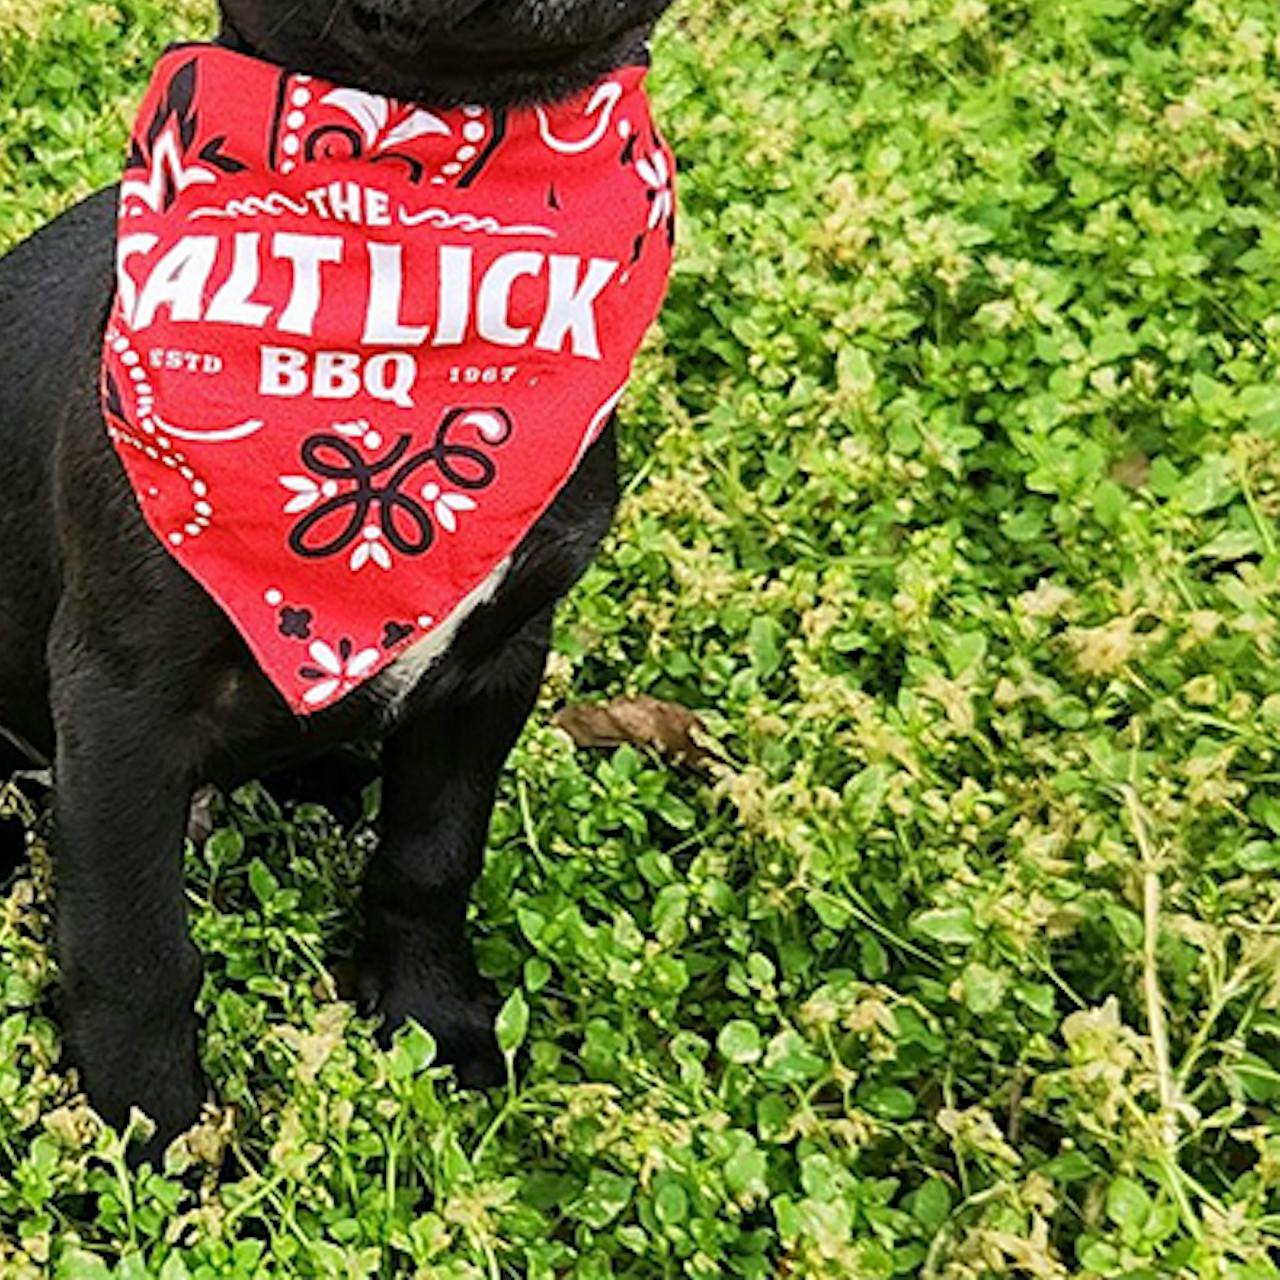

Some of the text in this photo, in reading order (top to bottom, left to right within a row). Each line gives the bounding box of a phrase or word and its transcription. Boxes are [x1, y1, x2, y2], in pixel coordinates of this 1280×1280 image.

[311, 181, 391, 227] THE
[361, 242, 619, 360] LICK
[148, 345, 518, 408] ESTD BBQ 1967
